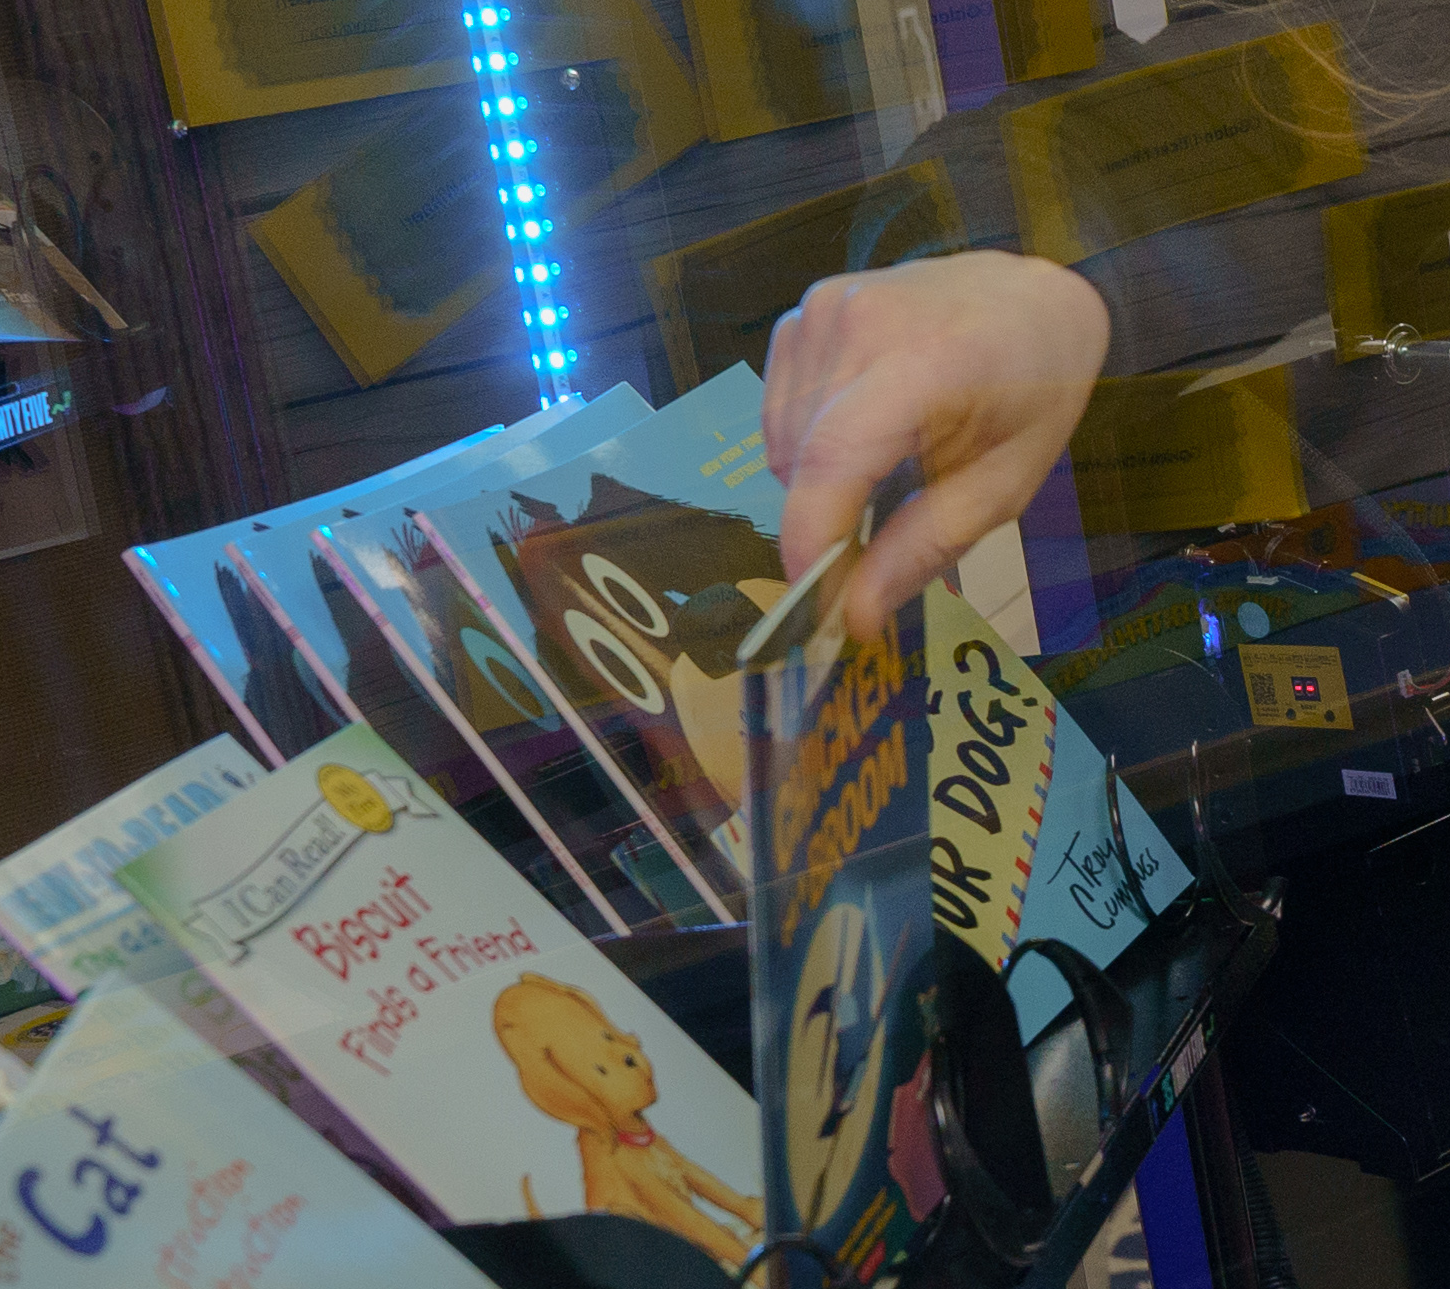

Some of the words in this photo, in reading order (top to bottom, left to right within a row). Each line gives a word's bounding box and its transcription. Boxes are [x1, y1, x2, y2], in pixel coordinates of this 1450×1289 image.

[23, 390, 54, 435] FIVE
[932, 639, 1039, 835] DOG?
[223, 898, 251, 928] I
[237, 874, 297, 918] Can
[276, 812, 347, 879] Read!
[289, 865, 433, 982] Biscuit
[415, 916, 540, 984] Friend
[338, 984, 421, 1078] Finds
[405, 963, 437, 995] a
[11, 1102, 165, 1258] Cat
